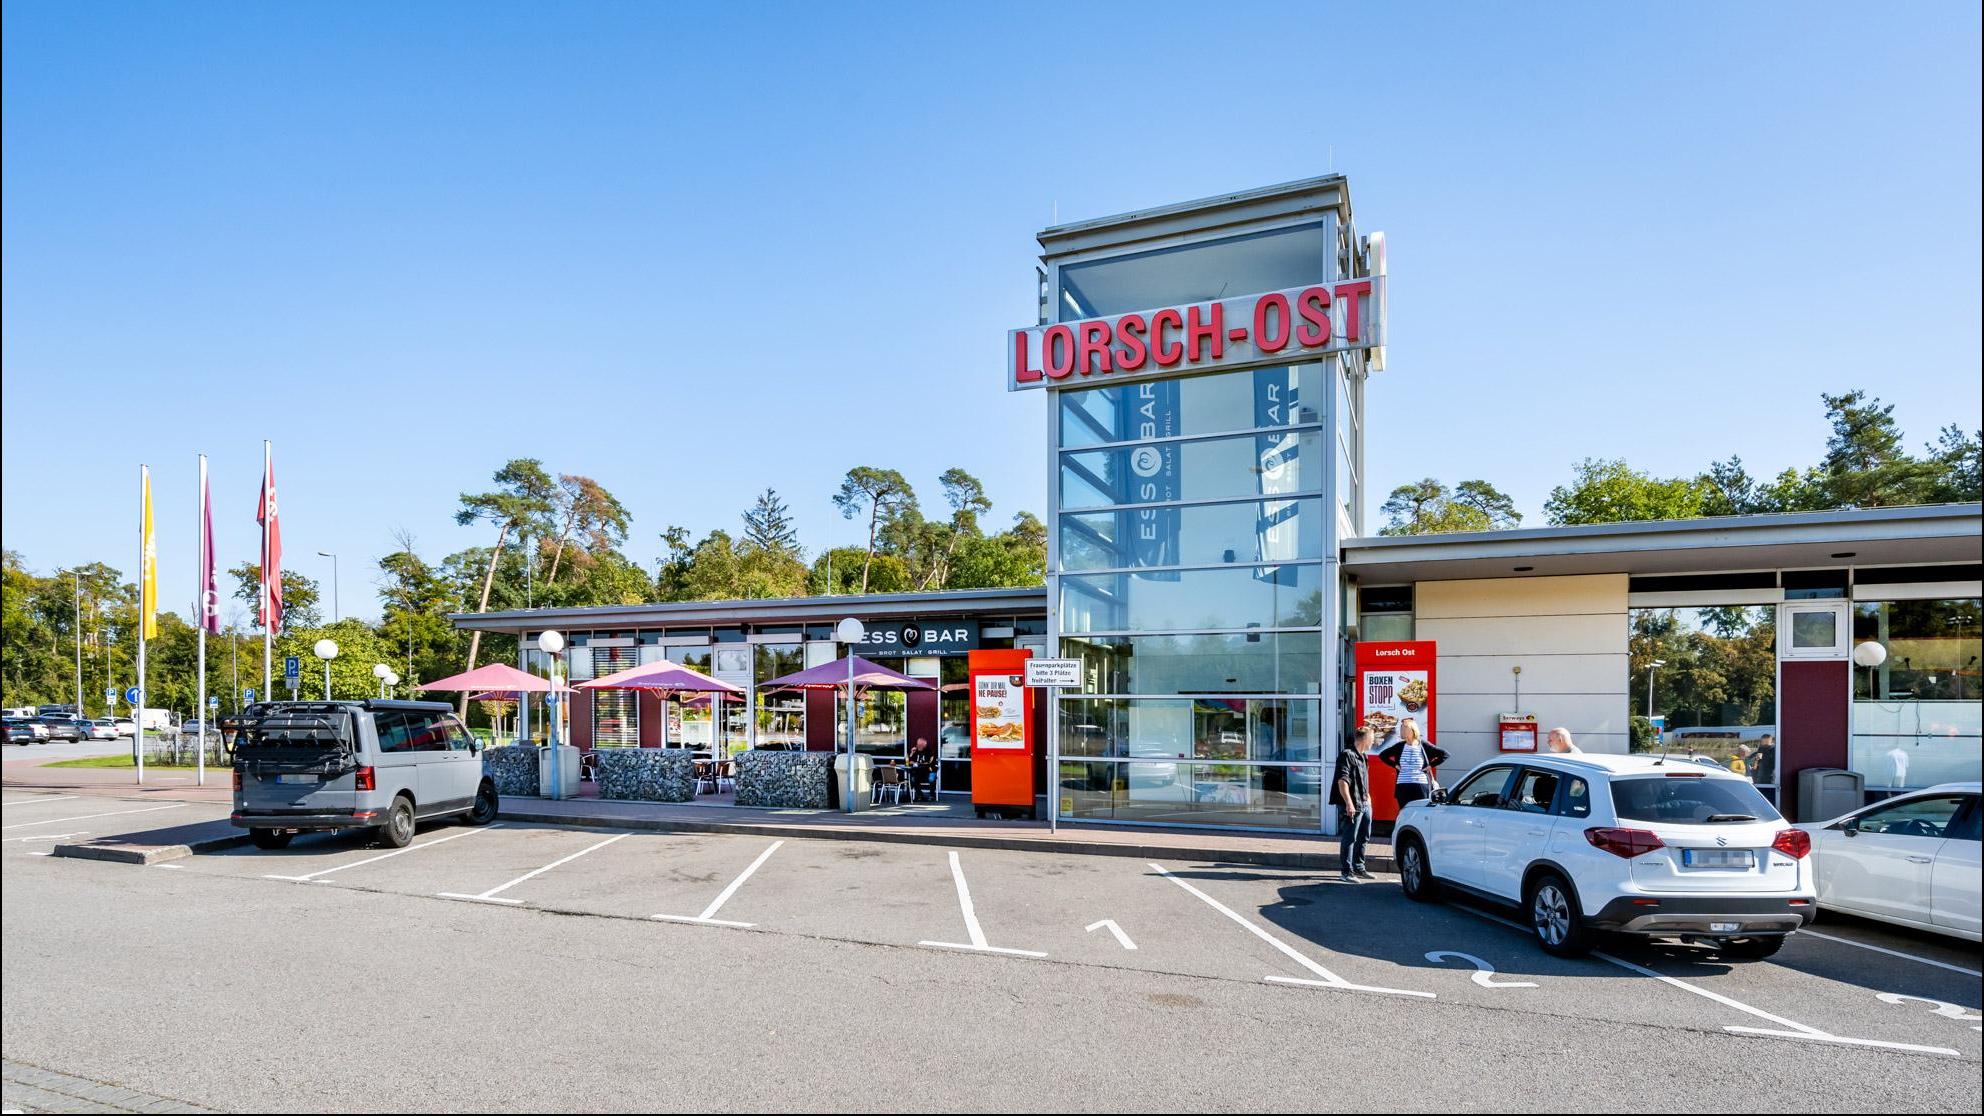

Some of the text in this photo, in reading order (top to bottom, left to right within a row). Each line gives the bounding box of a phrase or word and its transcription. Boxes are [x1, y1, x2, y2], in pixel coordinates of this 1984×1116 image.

[1015, 281, 1371, 383] LORSCH-OST
[1140, 382, 1156, 539] ESS BAR
[860, 629, 969, 644] ESS BAR
[1375, 648, 1415, 656] Lorsch Ost
[1369, 676, 1393, 685] BOXEN
[1369, 685, 1393, 704] STOPP
[1085, 919, 1138, 950] 1
[1424, 951, 1540, 988] 2
